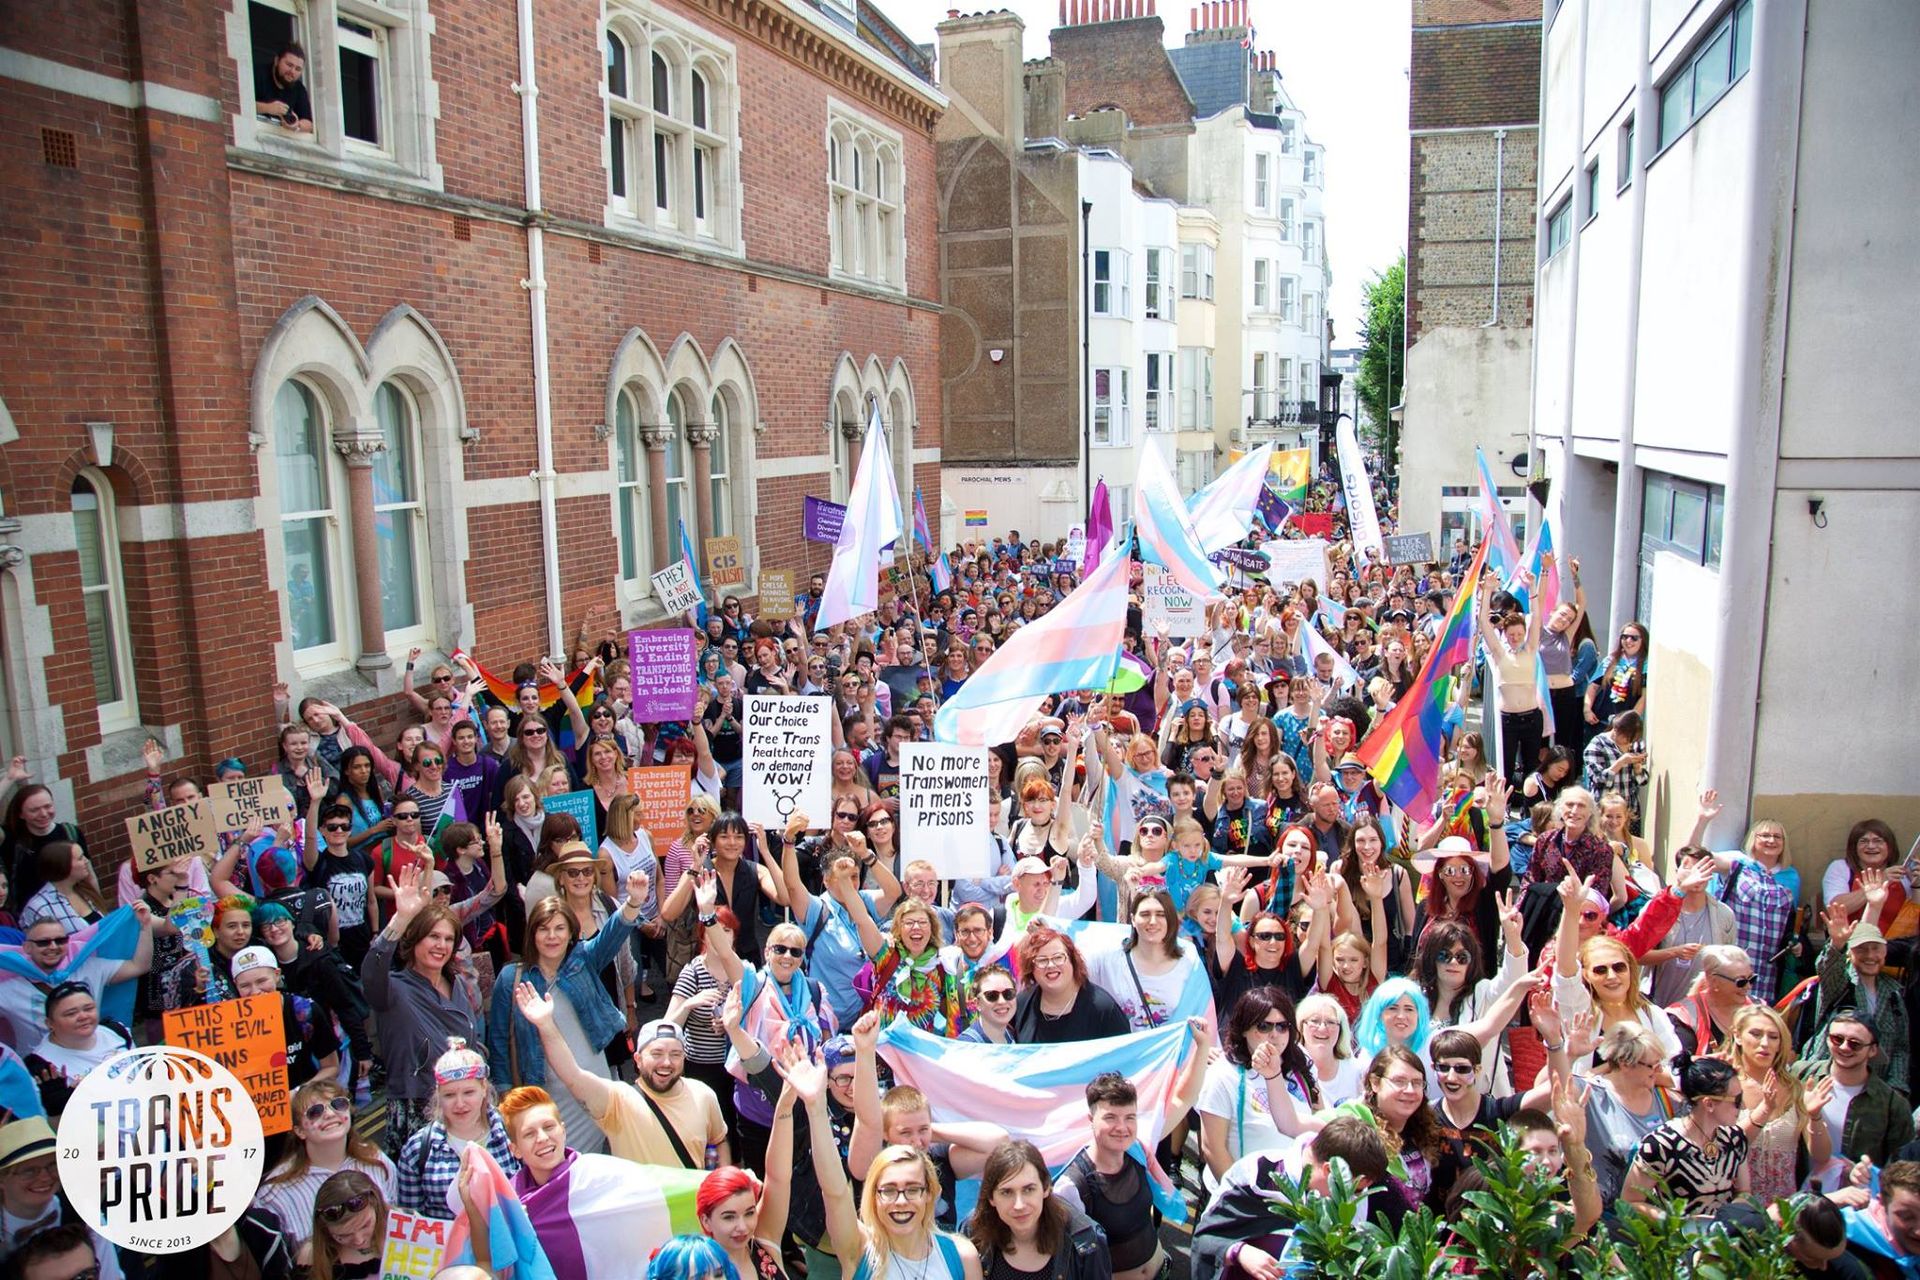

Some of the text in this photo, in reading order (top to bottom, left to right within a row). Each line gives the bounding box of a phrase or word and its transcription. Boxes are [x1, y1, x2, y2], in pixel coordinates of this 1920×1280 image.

[713, 554, 737, 568] CIS
[1230, 552, 1265, 570] NAIGATE
[674, 580, 690, 594] NOT
[667, 590, 700, 614] PLURAL
[1164, 596, 1193, 607] NOW
[634, 634, 690, 644] Embracing
[635, 642, 690, 653] Diversity
[636, 652, 690, 663] & Ending
[636, 663, 692, 675] TRANSPHOBIC
[637, 674, 692, 686] Bullying
[652, 685, 693, 695] Schools.
[751, 700, 820, 714] Our bodies
[749, 714, 809, 727] Our Choice
[748, 731, 821, 745] Free Trans
[752, 746, 816, 758] healthcare
[751, 760, 813, 772] on demand
[912, 755, 981, 771] No more
[633, 770, 687, 780] Embracing
[902, 773, 988, 790] Transwomen
[226, 779, 264, 798] FIGHT
[633, 779, 687, 790] Diversity
[645, 790, 686, 800] Ending
[910, 791, 972, 808] in men's
[234, 796, 261, 811] THE
[641, 799, 687, 809] PHOBIC
[150, 822, 193, 846] PUNK
[144, 834, 205, 866] & TRANS
[170, 999, 253, 1029] THIS IS
[177, 1027, 225, 1049] THE
[243, 1069, 284, 1090] THE
